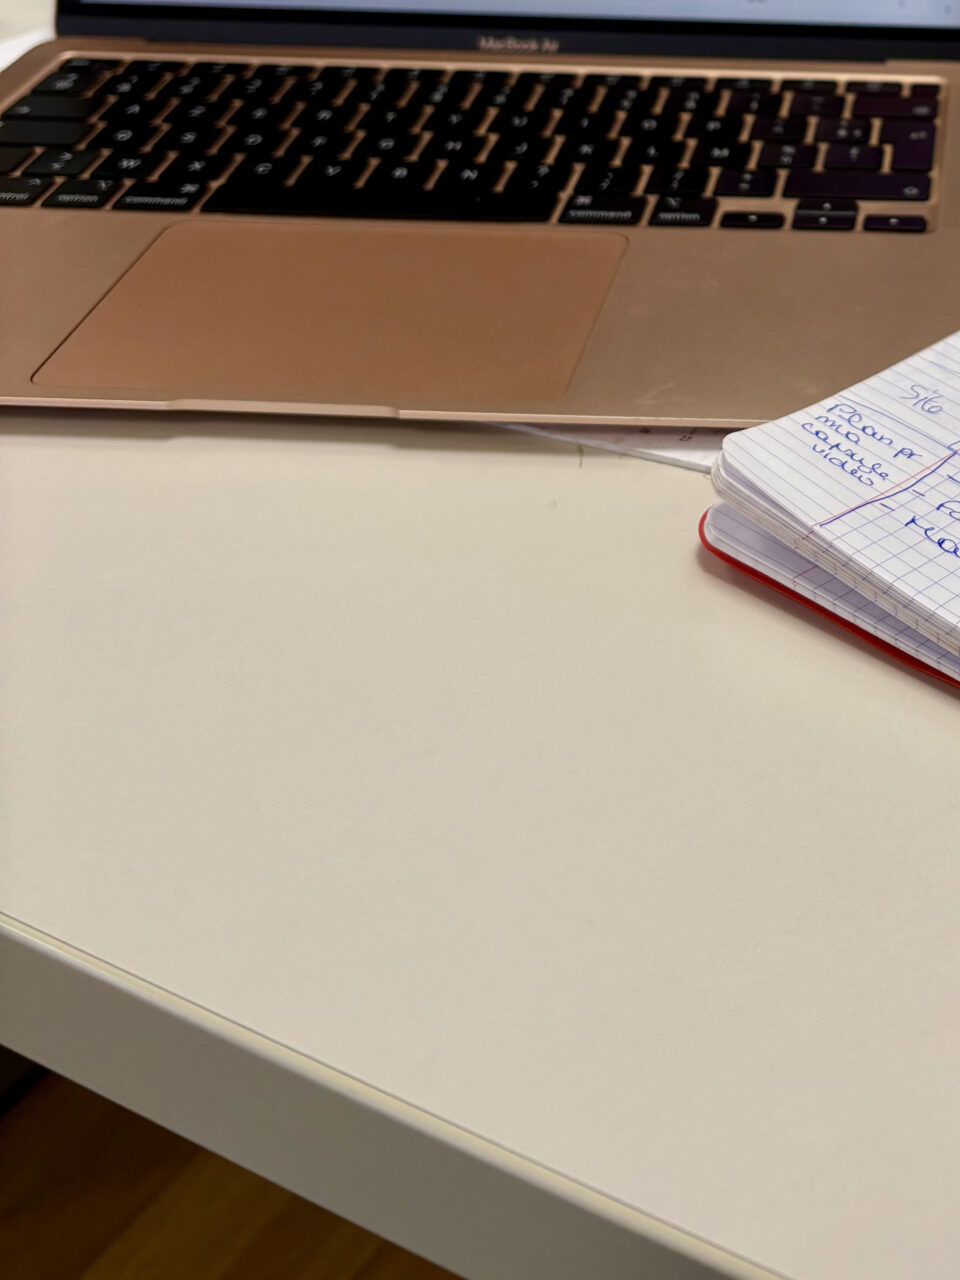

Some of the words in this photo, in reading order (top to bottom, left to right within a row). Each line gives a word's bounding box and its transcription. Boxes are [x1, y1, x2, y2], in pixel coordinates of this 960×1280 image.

[477, 36, 538, 51] MacBook
[899, 383, 945, 416] Site
[826, 402, 894, 447] Plan
